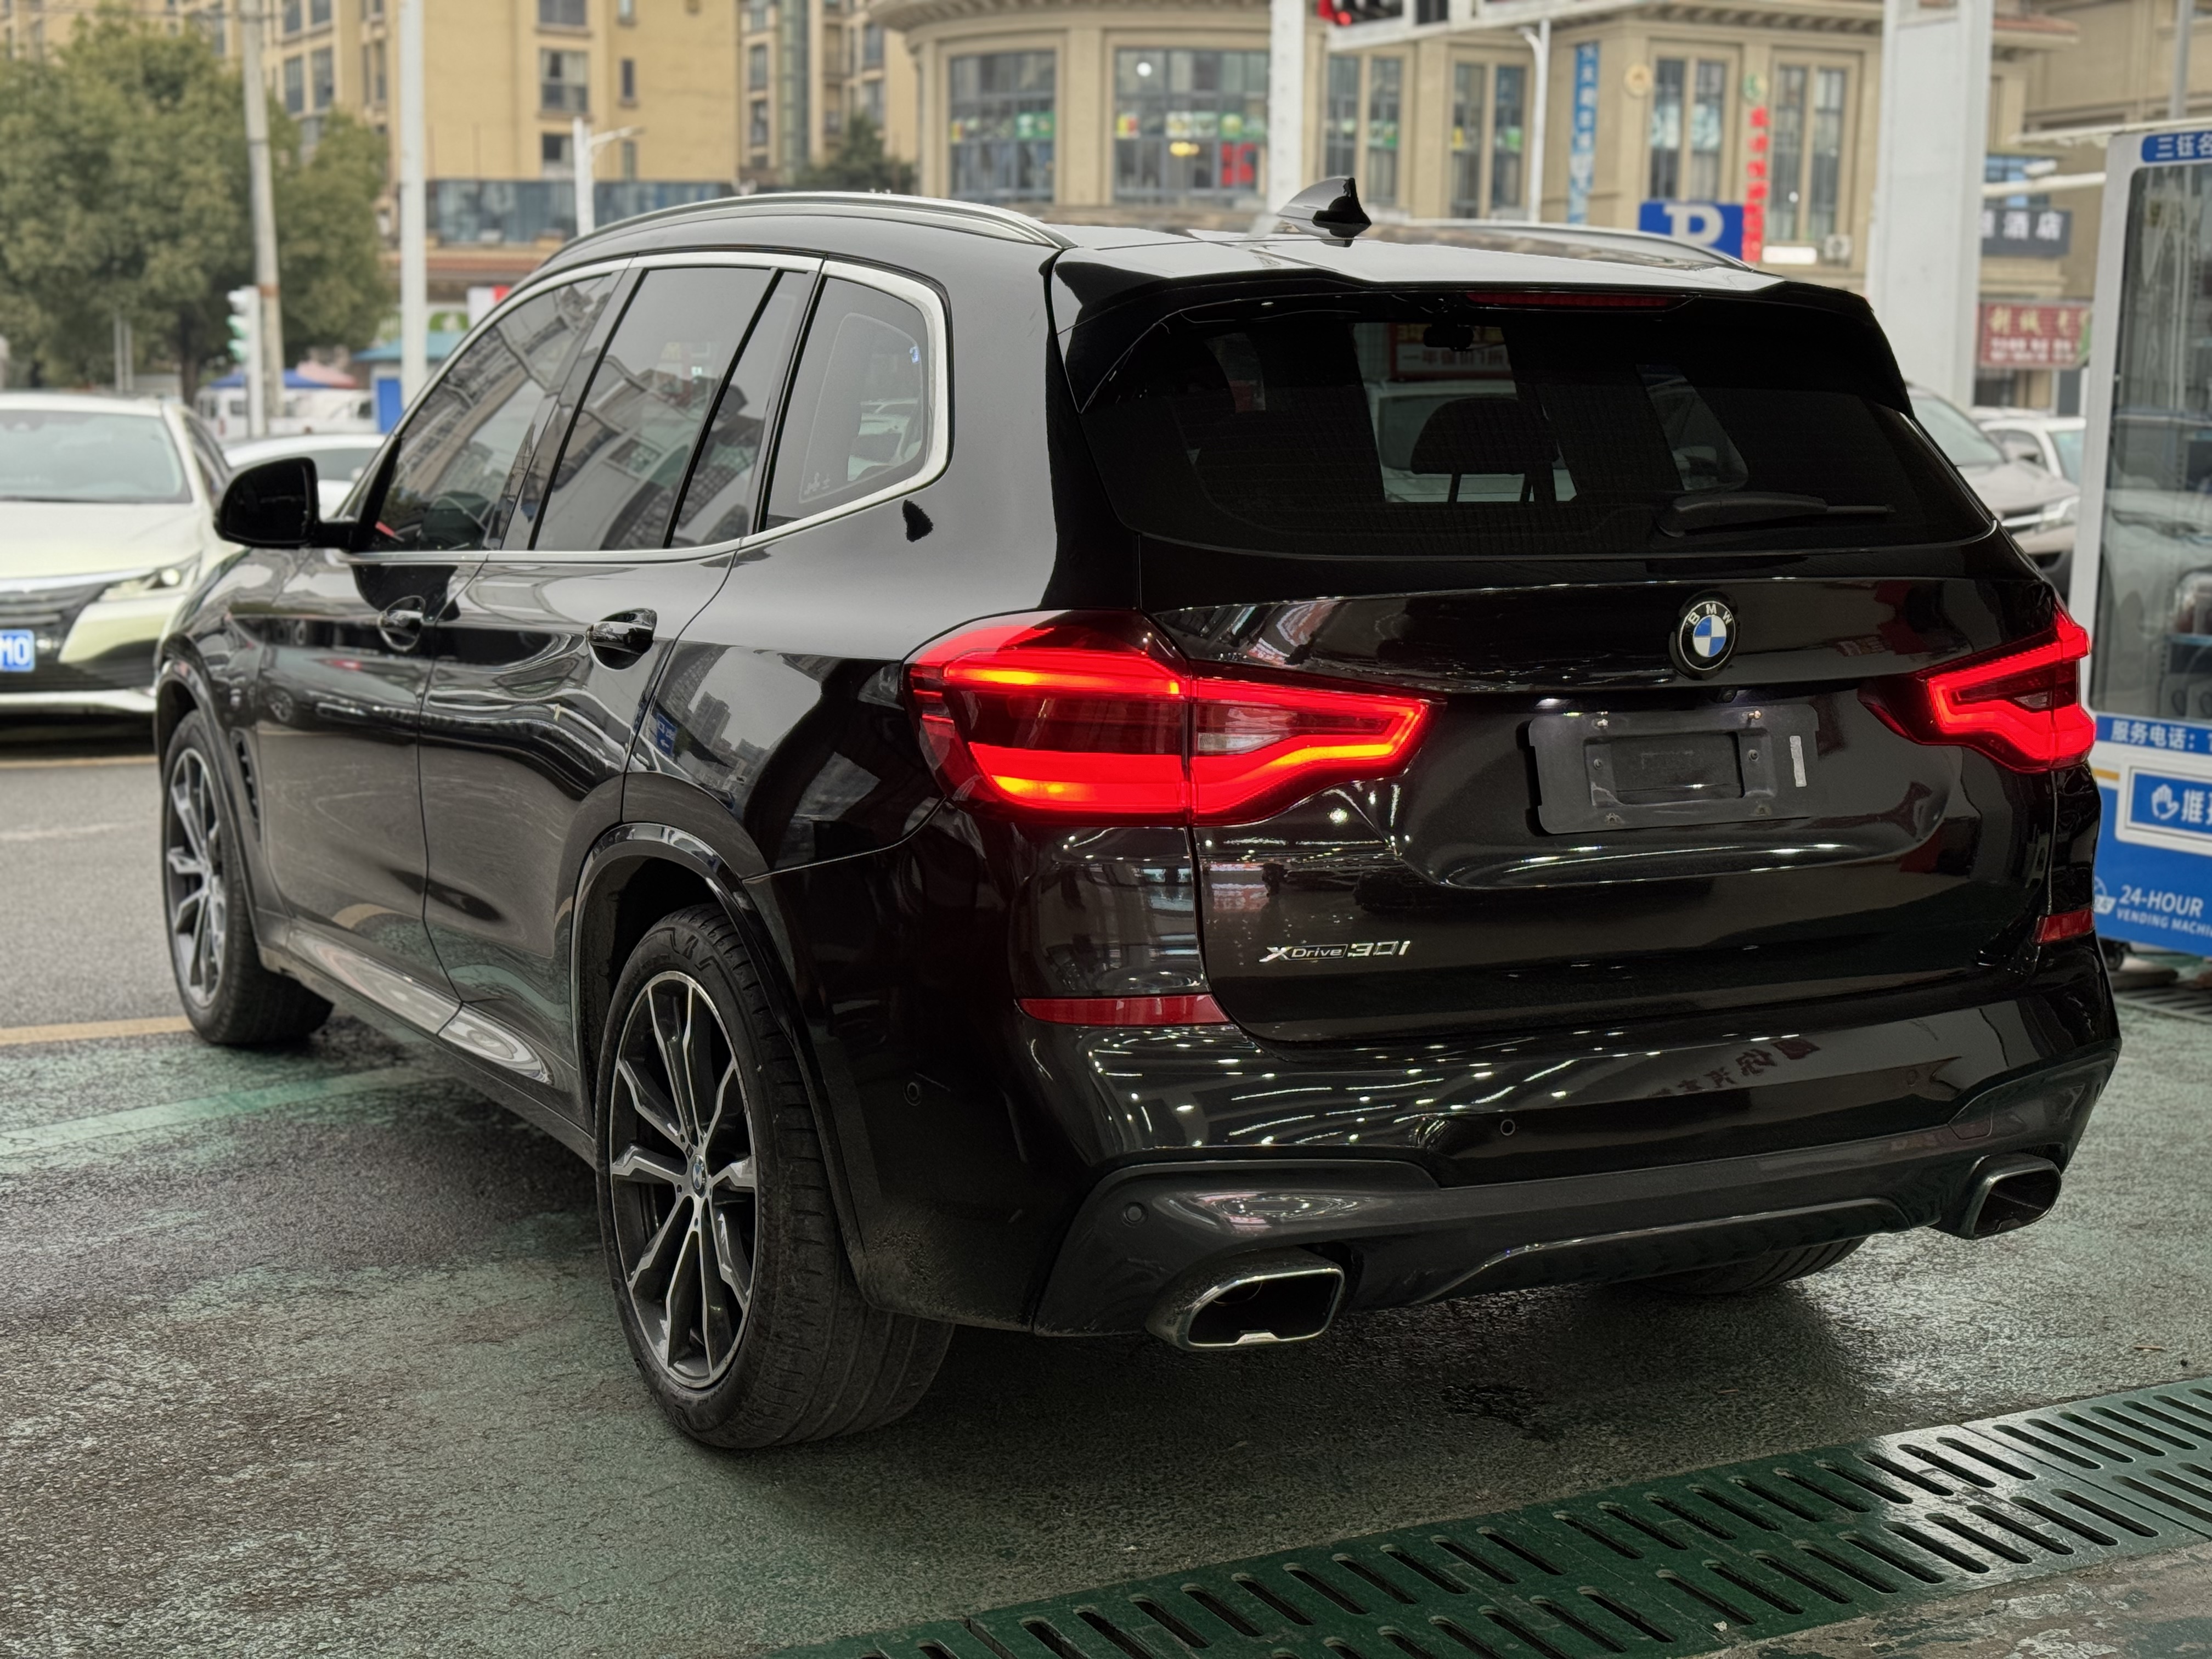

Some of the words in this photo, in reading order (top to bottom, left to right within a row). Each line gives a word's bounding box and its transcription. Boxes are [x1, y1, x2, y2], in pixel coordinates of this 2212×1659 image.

[1663, 205, 1724, 246] P
[1688, 603, 1732, 625] BMW
[2119, 884, 2204, 918] 24-HOUR
[2117, 907, 2169, 929] VENDING
